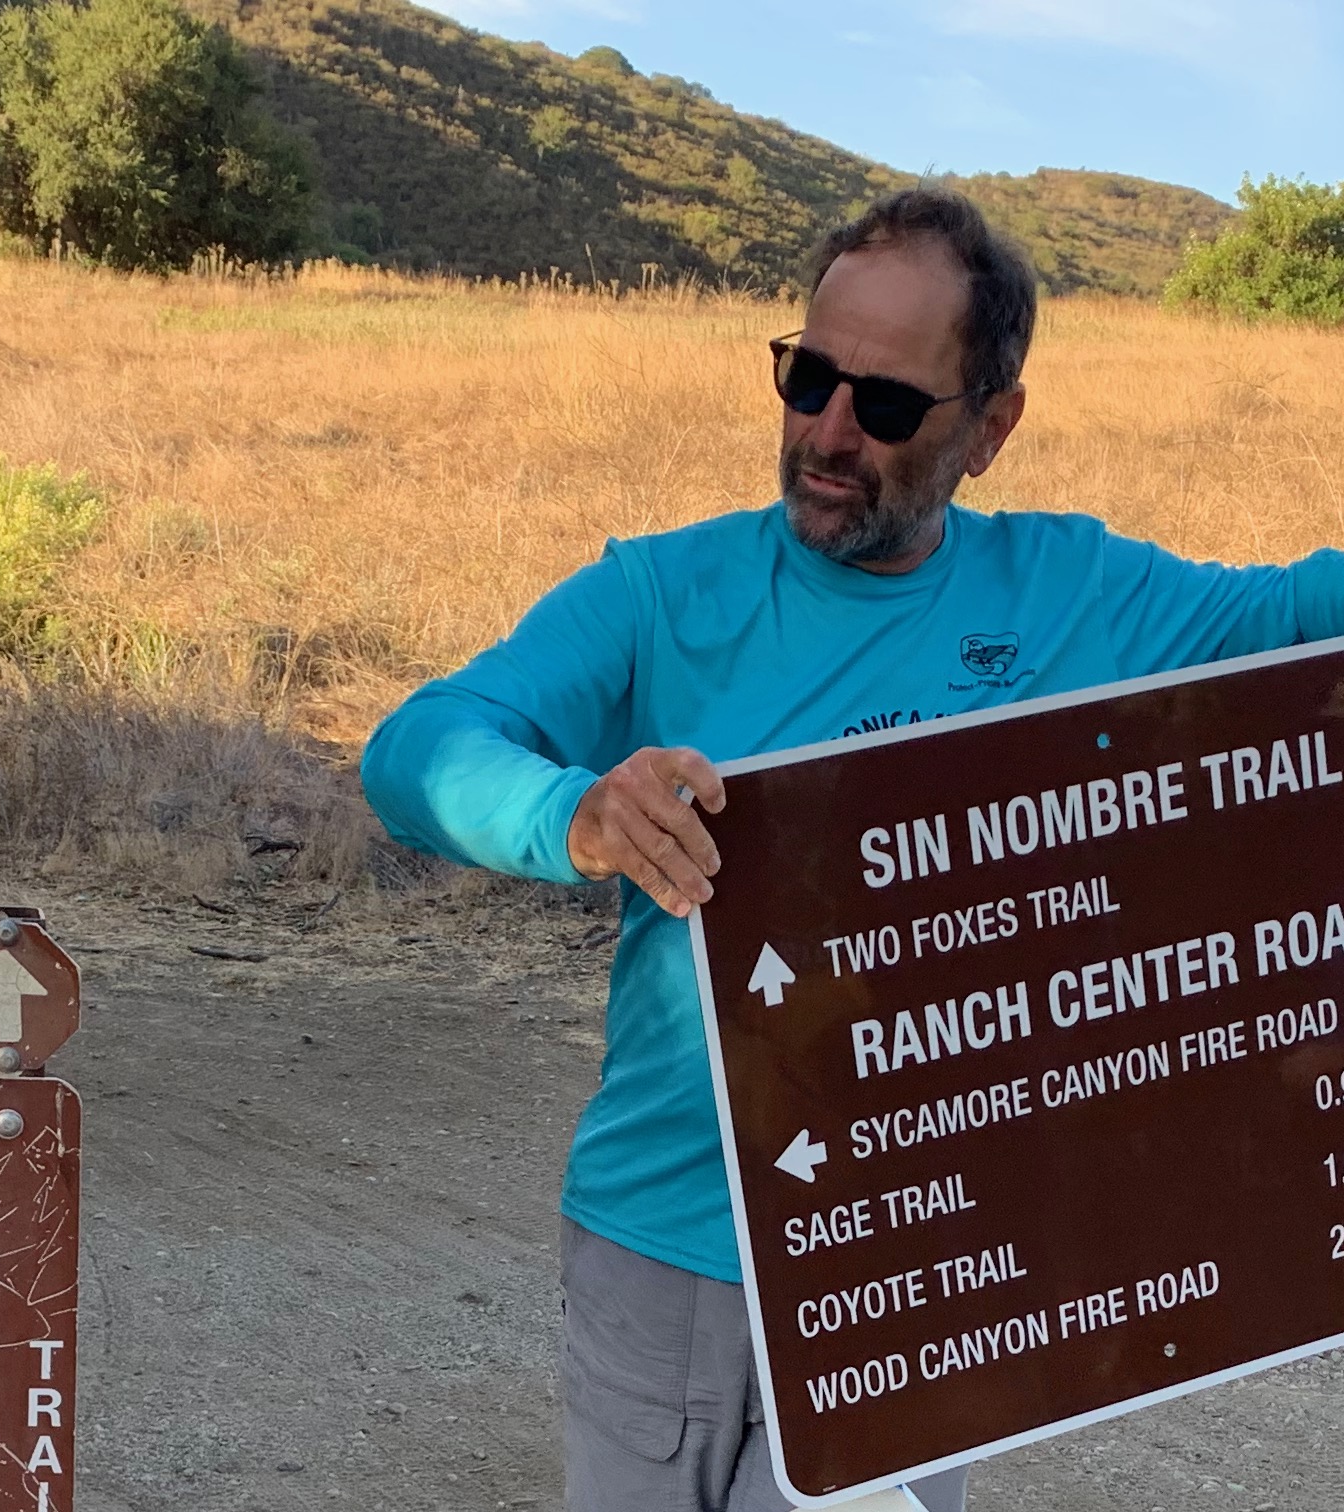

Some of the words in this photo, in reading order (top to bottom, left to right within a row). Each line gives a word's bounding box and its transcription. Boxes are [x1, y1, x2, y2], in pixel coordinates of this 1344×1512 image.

[861, 814, 950, 888] SIN
[967, 762, 1187, 864] NOMBRE
[1200, 731, 1343, 809] TRAIL
[823, 926, 900, 977] TWO
[912, 898, 1018, 957] FOXES
[1027, 876, 1120, 928] TRAIL
[851, 982, 1031, 1078] RANCH
[1049, 932, 1239, 1027] CENTER
[851, 1077, 1032, 1158] SYCAMORE
[1042, 1041, 1169, 1107] CANYON
[1180, 1021, 1247, 1071] FIRE
[1257, 999, 1338, 1051] ROAD
[785, 1199, 873, 1256] SAGE
[881, 1174, 976, 1228] TRAIL
[798, 1269, 926, 1338] COYOTE
[934, 1243, 1027, 1297] TRAIL
[806, 1354, 908, 1413] WOOD
[920, 1310, 1049, 1379] CANYON
[1059, 1287, 1127, 1339] FIRE
[1136, 1261, 1219, 1315] ROAD
